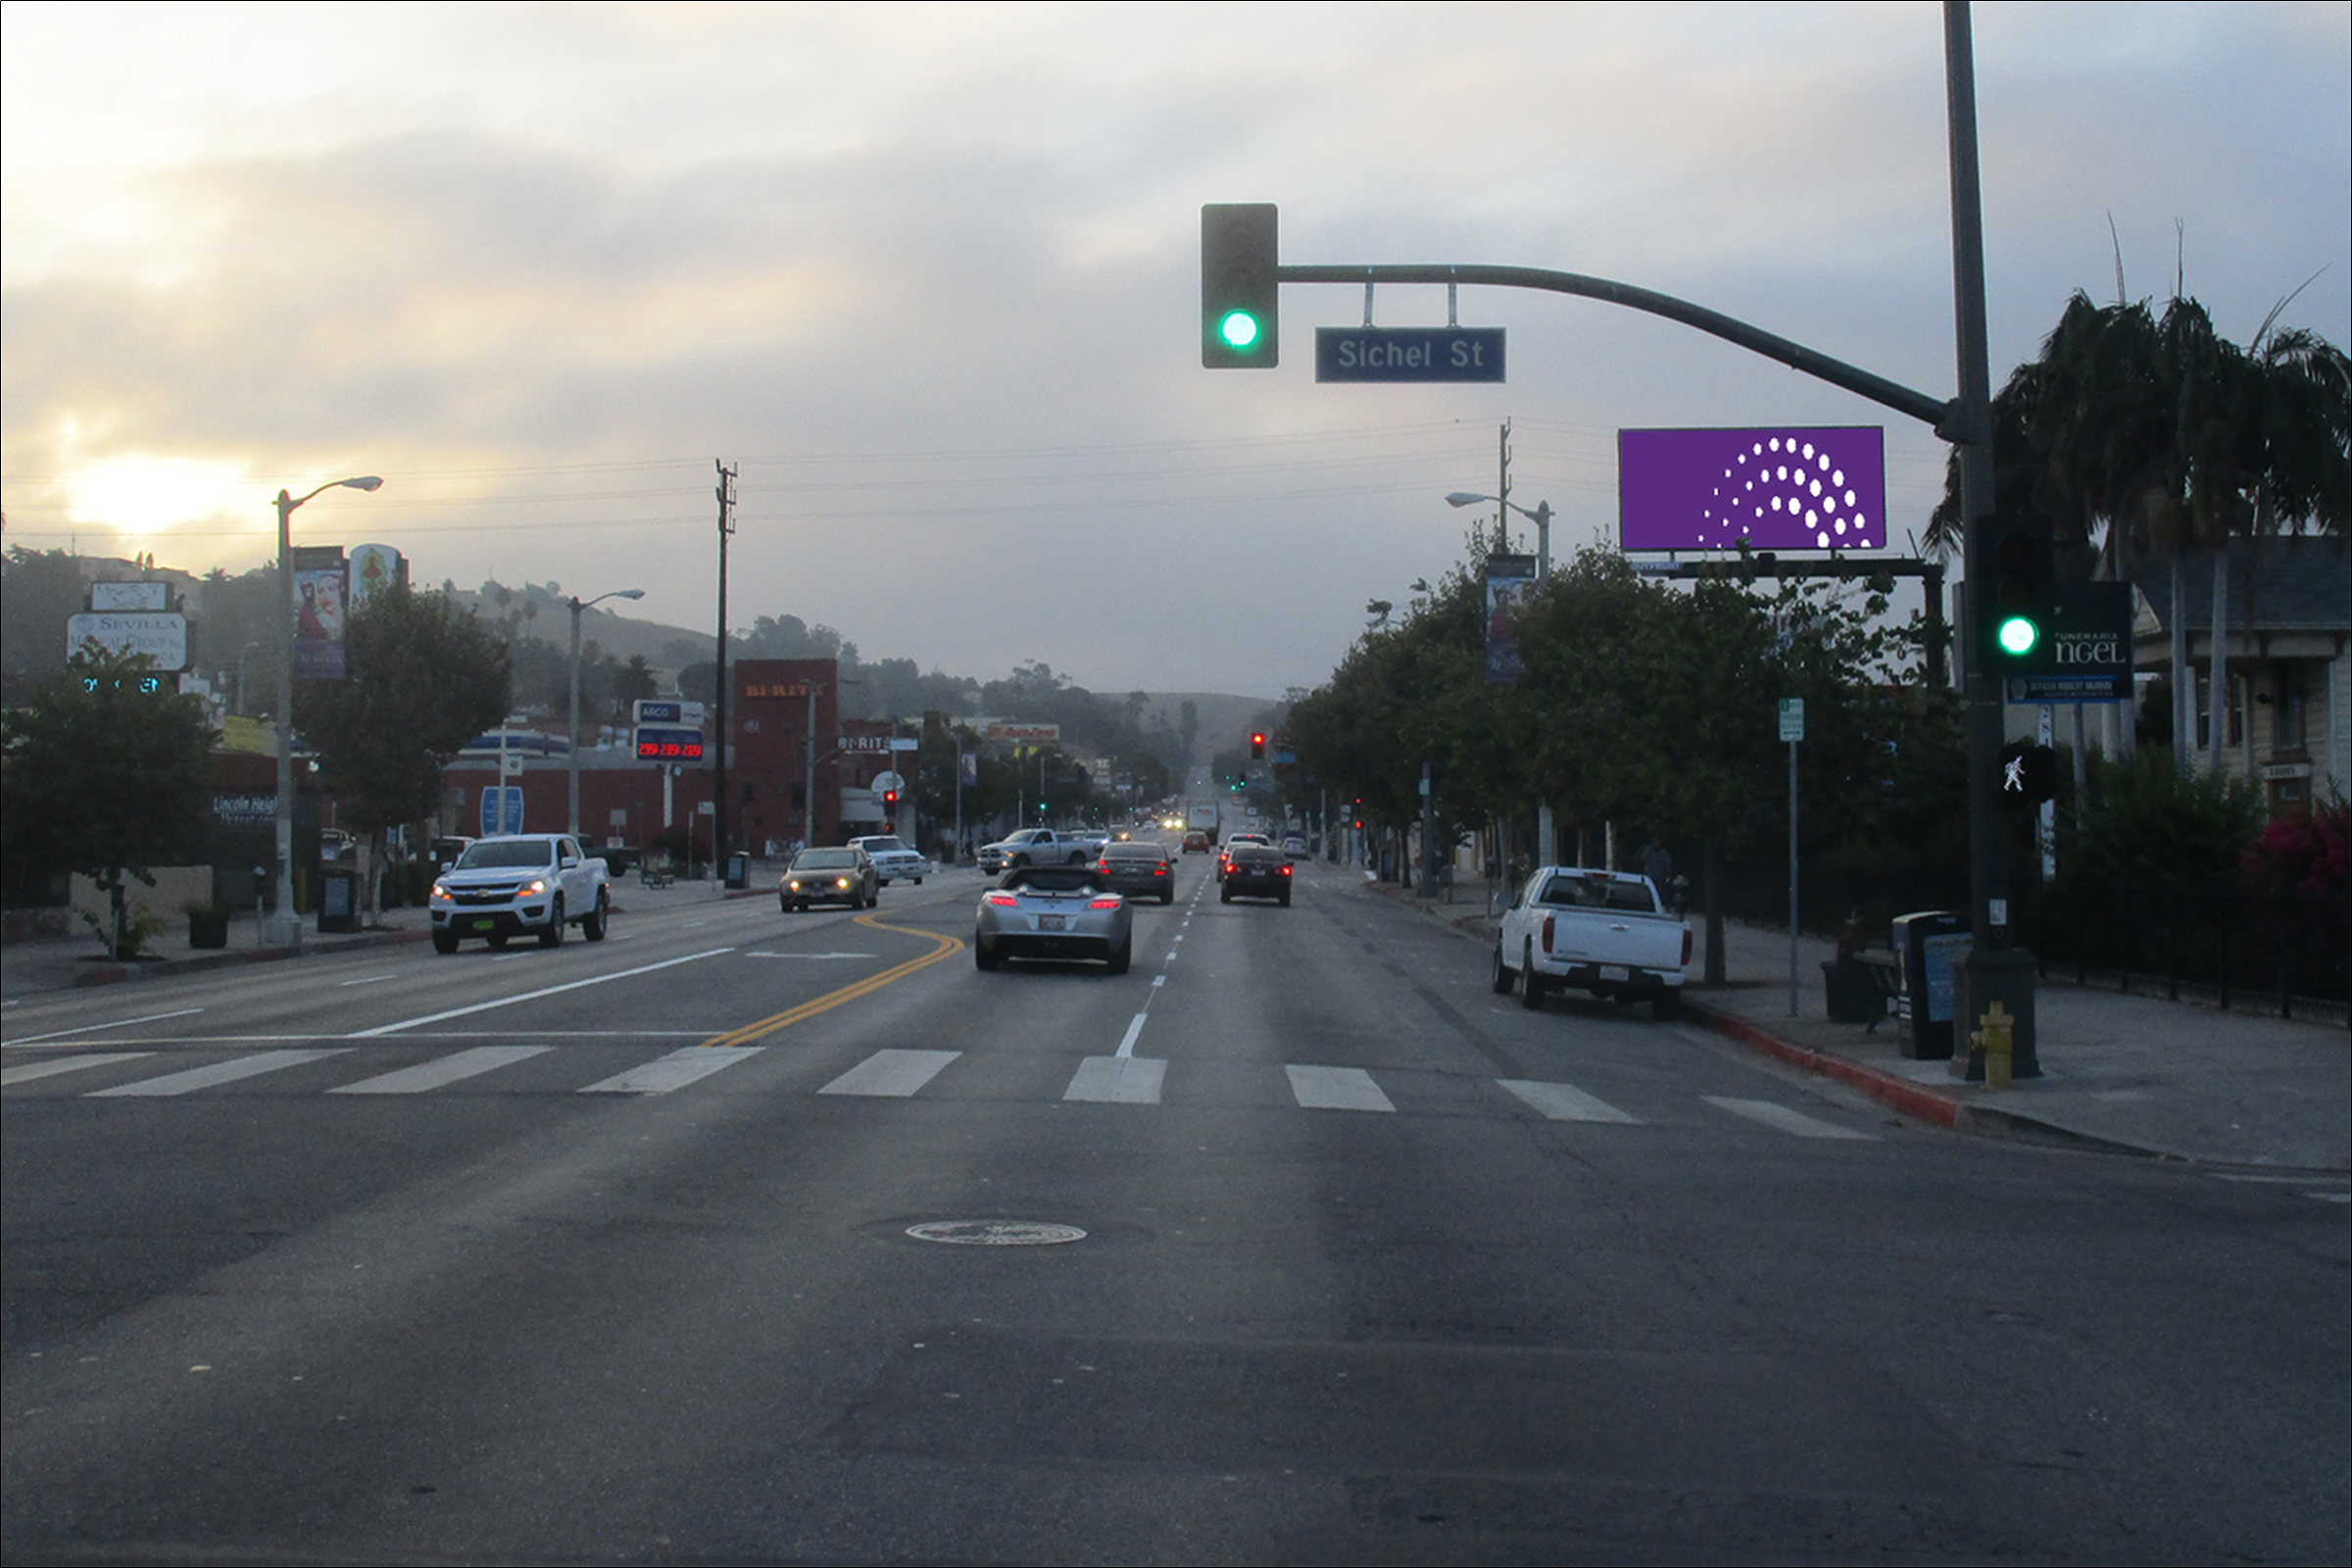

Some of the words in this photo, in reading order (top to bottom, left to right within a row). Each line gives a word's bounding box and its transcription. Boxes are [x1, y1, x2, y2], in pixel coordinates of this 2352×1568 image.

[1338, 340, 1431, 368] Sichel
[1449, 340, 1485, 368] St
[100, 616, 178, 630] SEVILLA
[643, 707, 669, 717] ARCO
[213, 795, 250, 811] Lincoln
